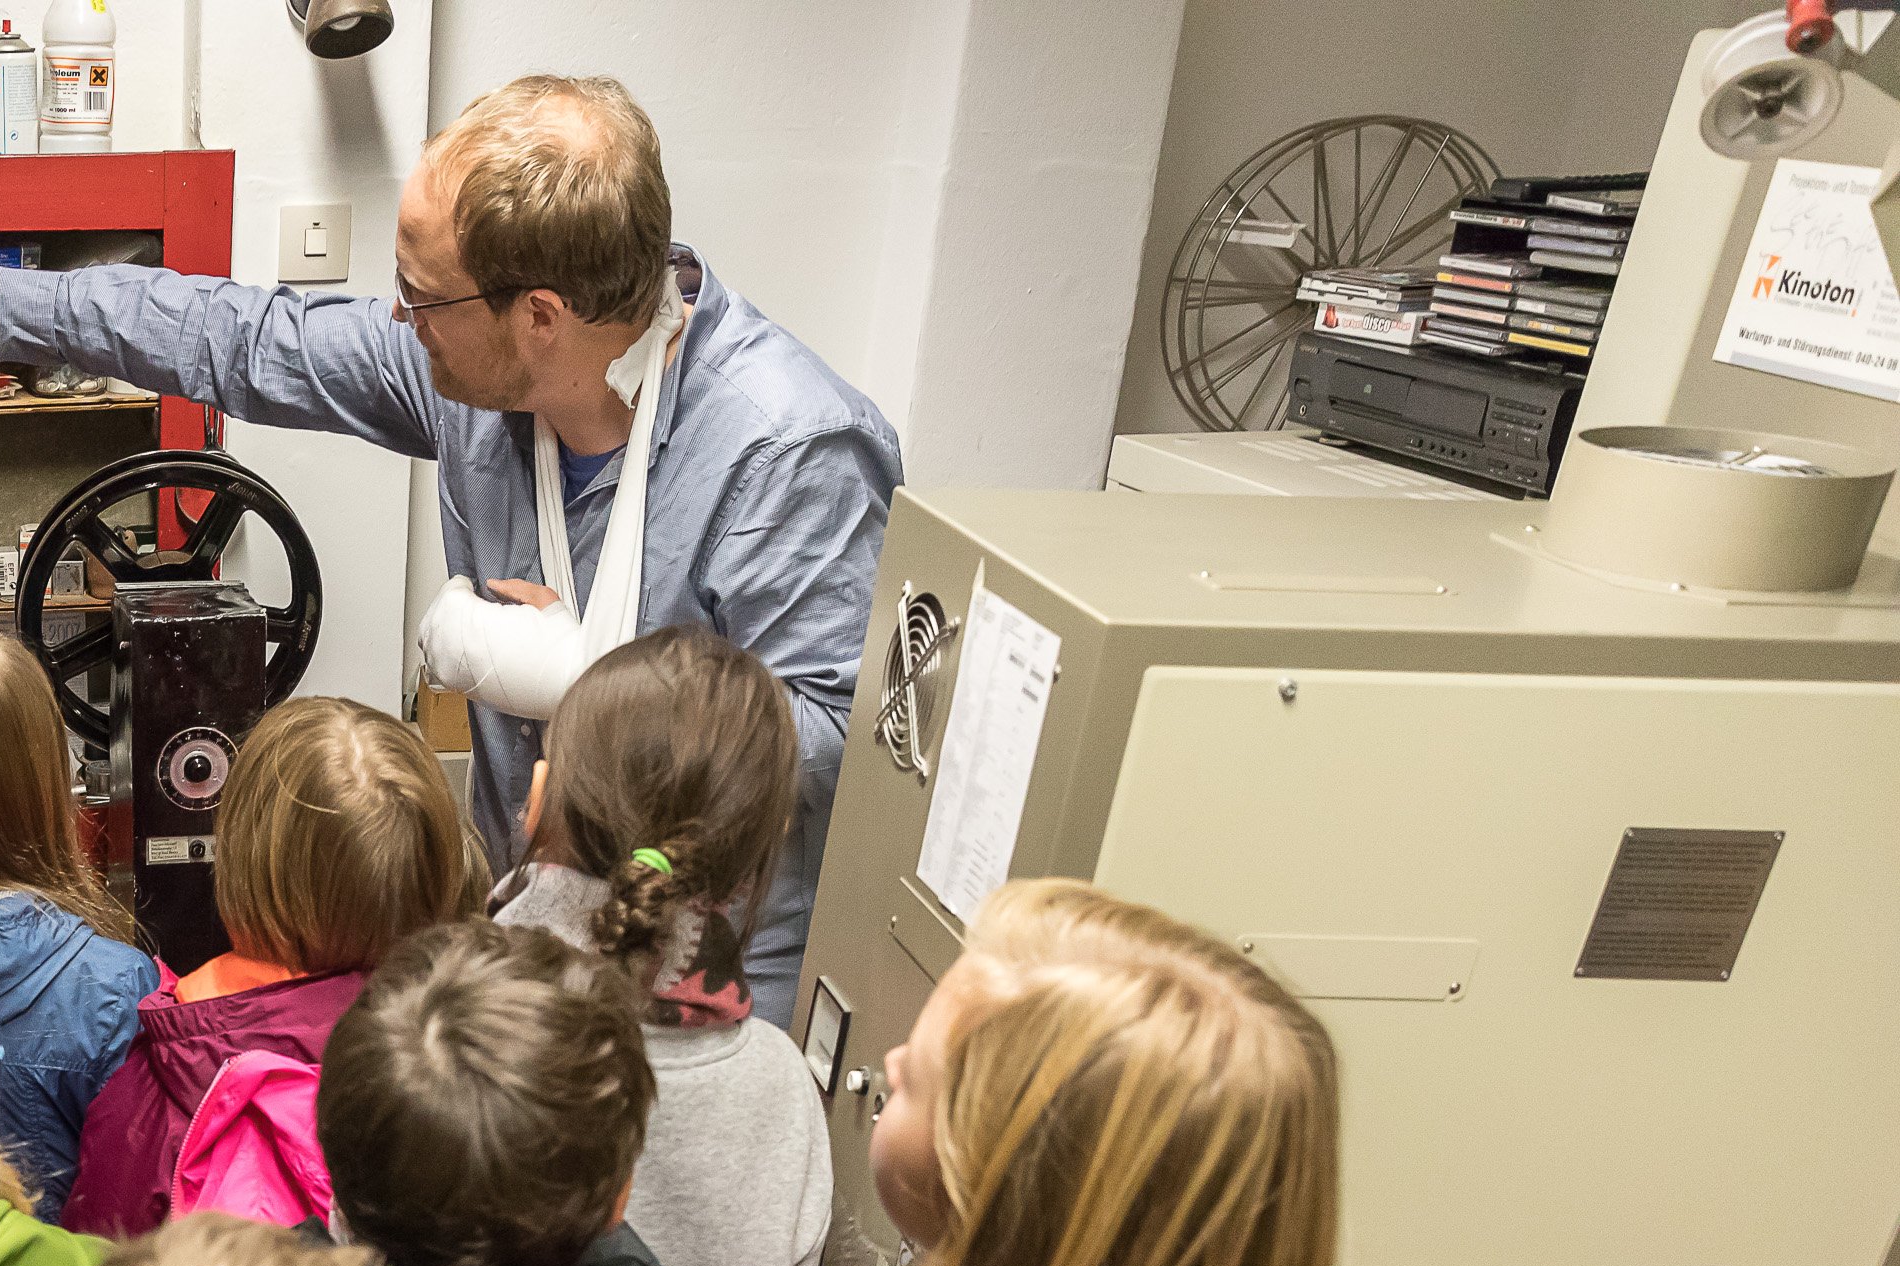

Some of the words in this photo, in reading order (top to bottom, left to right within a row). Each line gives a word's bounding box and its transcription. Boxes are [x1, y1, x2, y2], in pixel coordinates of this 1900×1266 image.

[1778, 269, 1856, 305] Kinoton
[1363, 313, 1392, 333] disco
[1738, 326, 1776, 346] Wartungs-
[1777, 338, 1792, 349] und
[7, 562, 15, 577] EPT
